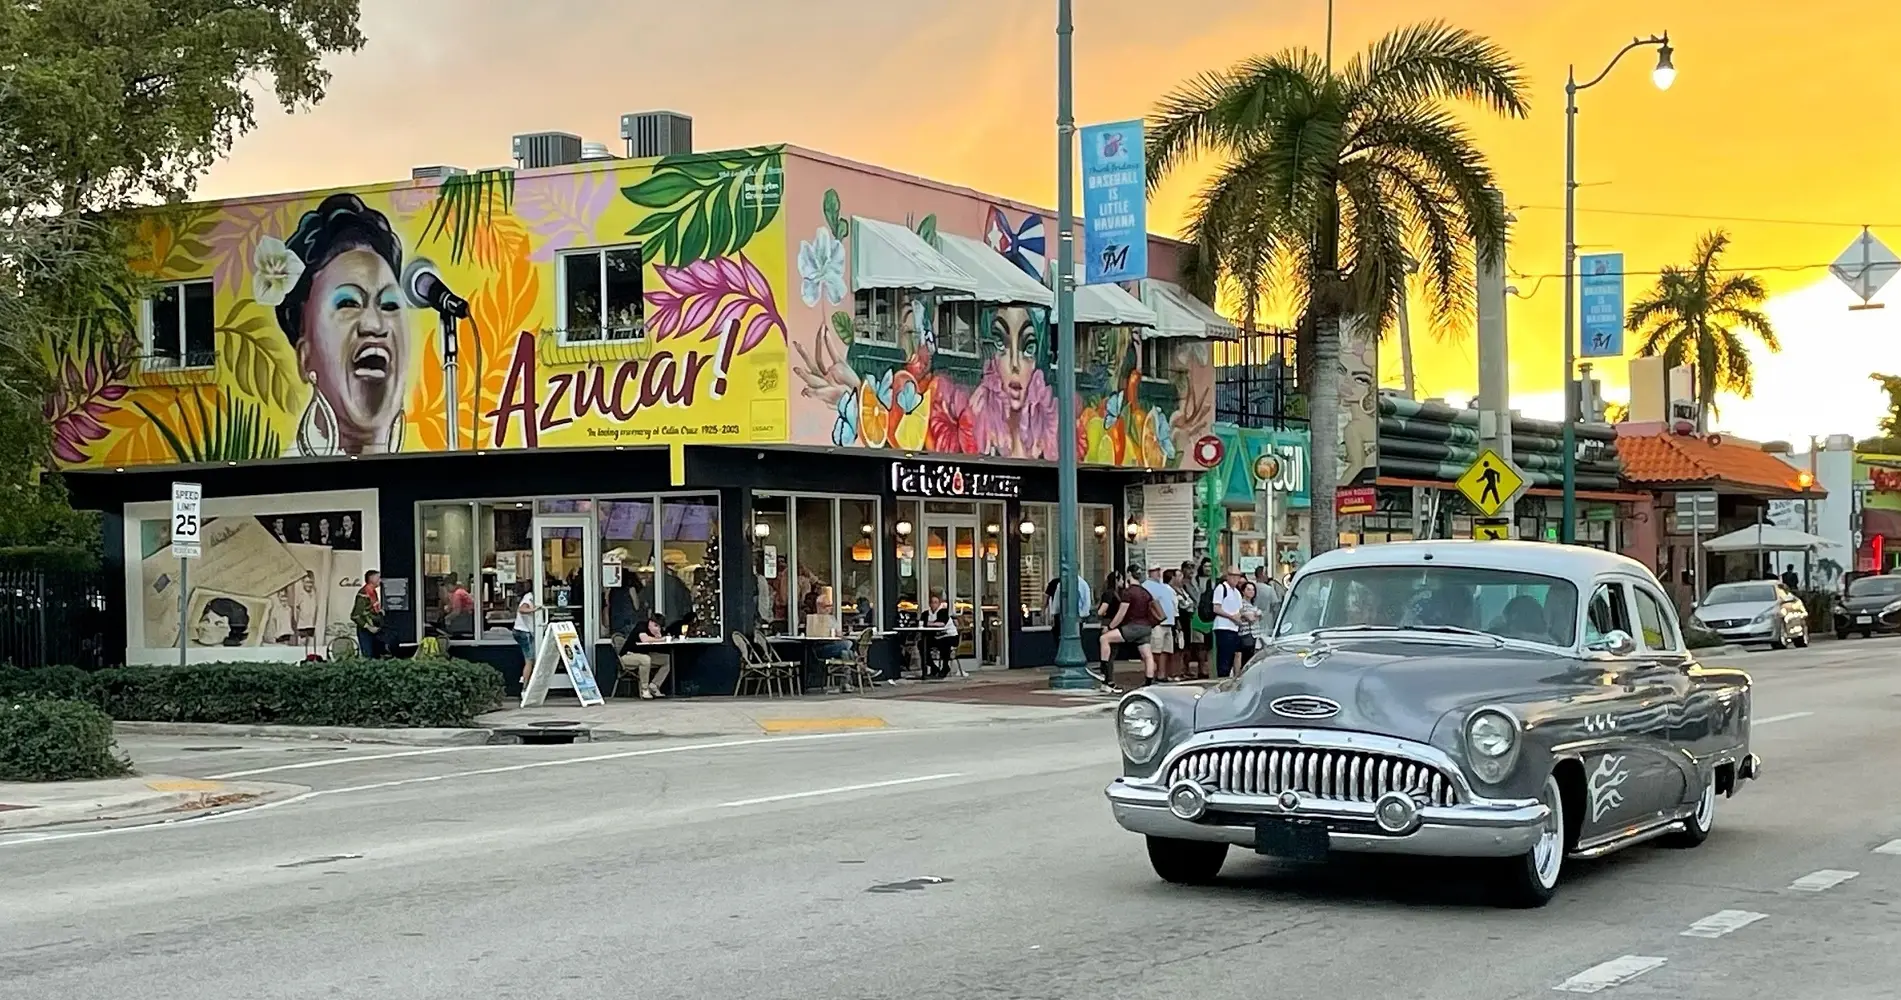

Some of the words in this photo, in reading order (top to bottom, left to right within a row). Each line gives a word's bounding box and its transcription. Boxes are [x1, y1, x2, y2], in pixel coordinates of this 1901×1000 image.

[1088, 171, 1139, 189] BASEBALL
[1108, 187, 1119, 200] IS
[1099, 201, 1129, 216] LITTLE
[1093, 215, 1136, 232] HAVANA
[485, 318, 741, 449] Azúcar!
[597, 427, 619, 441] loving
[661, 426, 679, 435] Celia
[680, 425, 698, 435] Cruz
[175, 490, 199, 500] SPEED
[176, 502, 197, 512] LIMIT
[175, 514, 197, 536] 25
